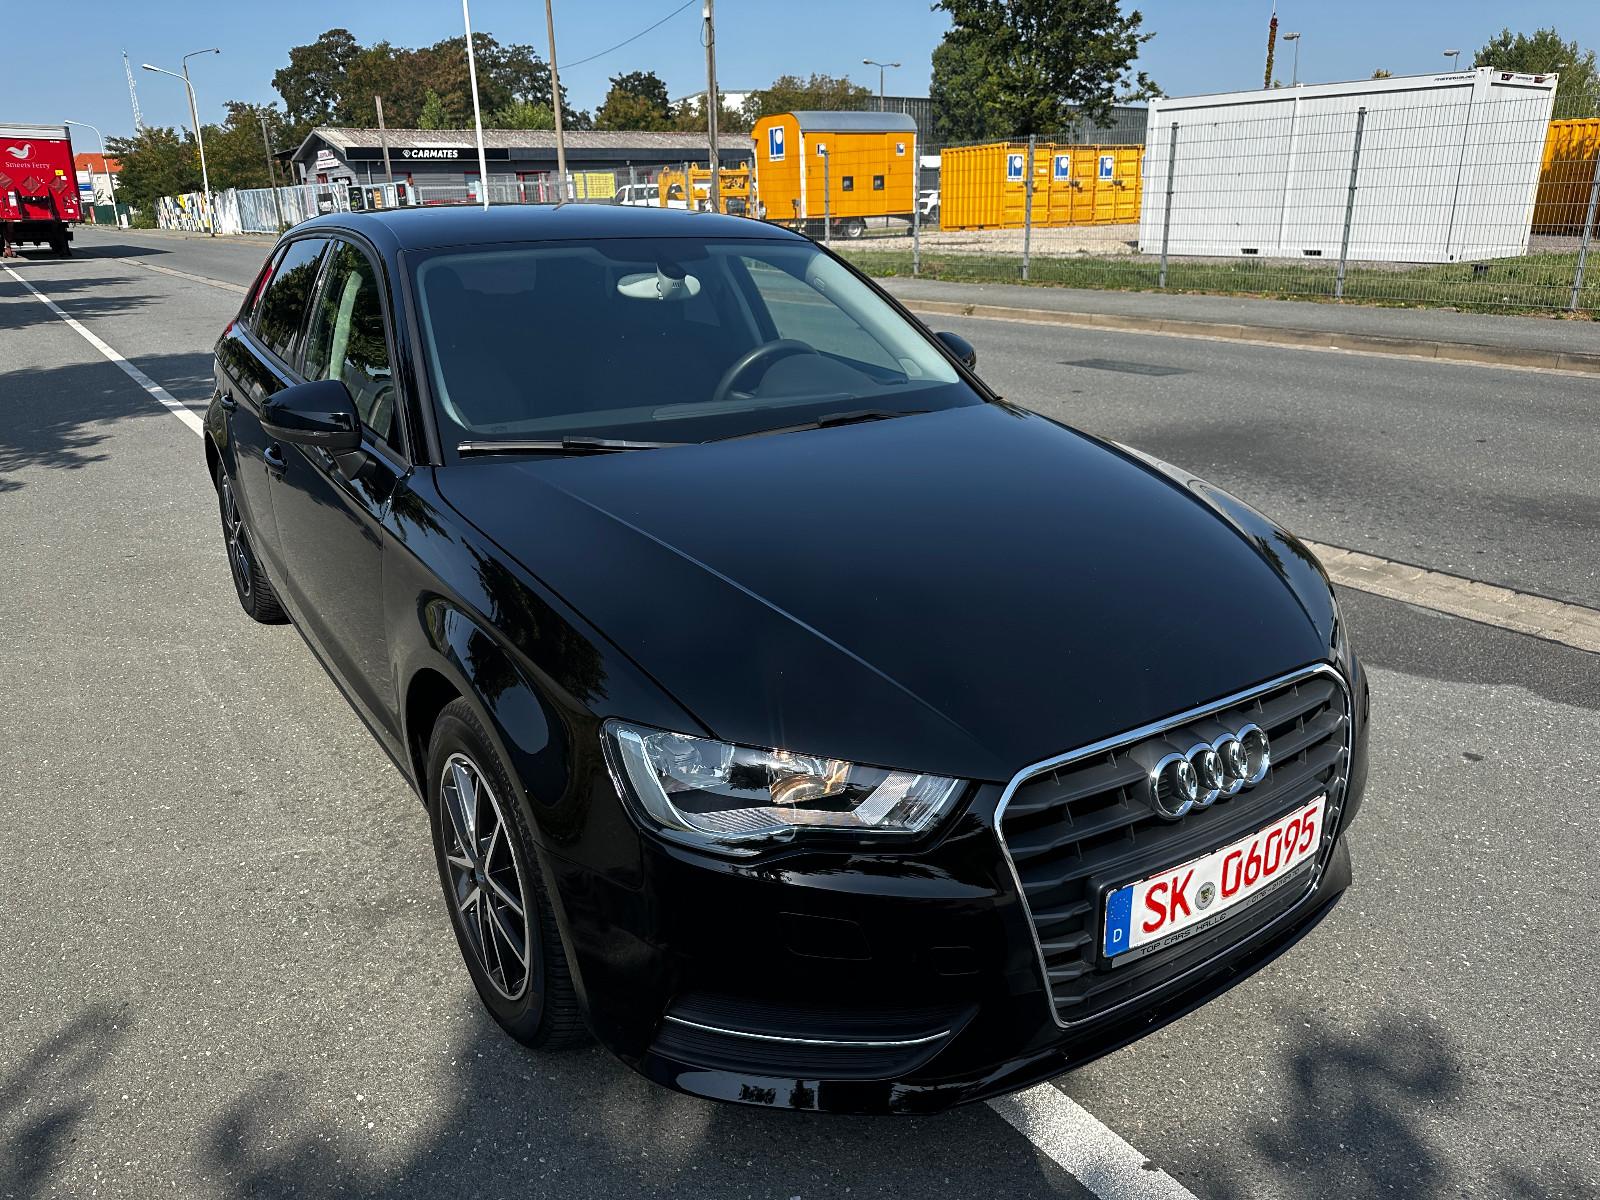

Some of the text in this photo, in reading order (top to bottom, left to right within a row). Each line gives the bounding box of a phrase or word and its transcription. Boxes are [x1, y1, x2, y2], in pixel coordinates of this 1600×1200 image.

[411, 149, 459, 158] CARMATES
[1142, 806, 1318, 934] SK 06095
[1113, 928, 1123, 943] D
[1140, 943, 1161, 955] TOP
[1163, 929, 1191, 946] CARS
[1195, 912, 1227, 932] HALLE
